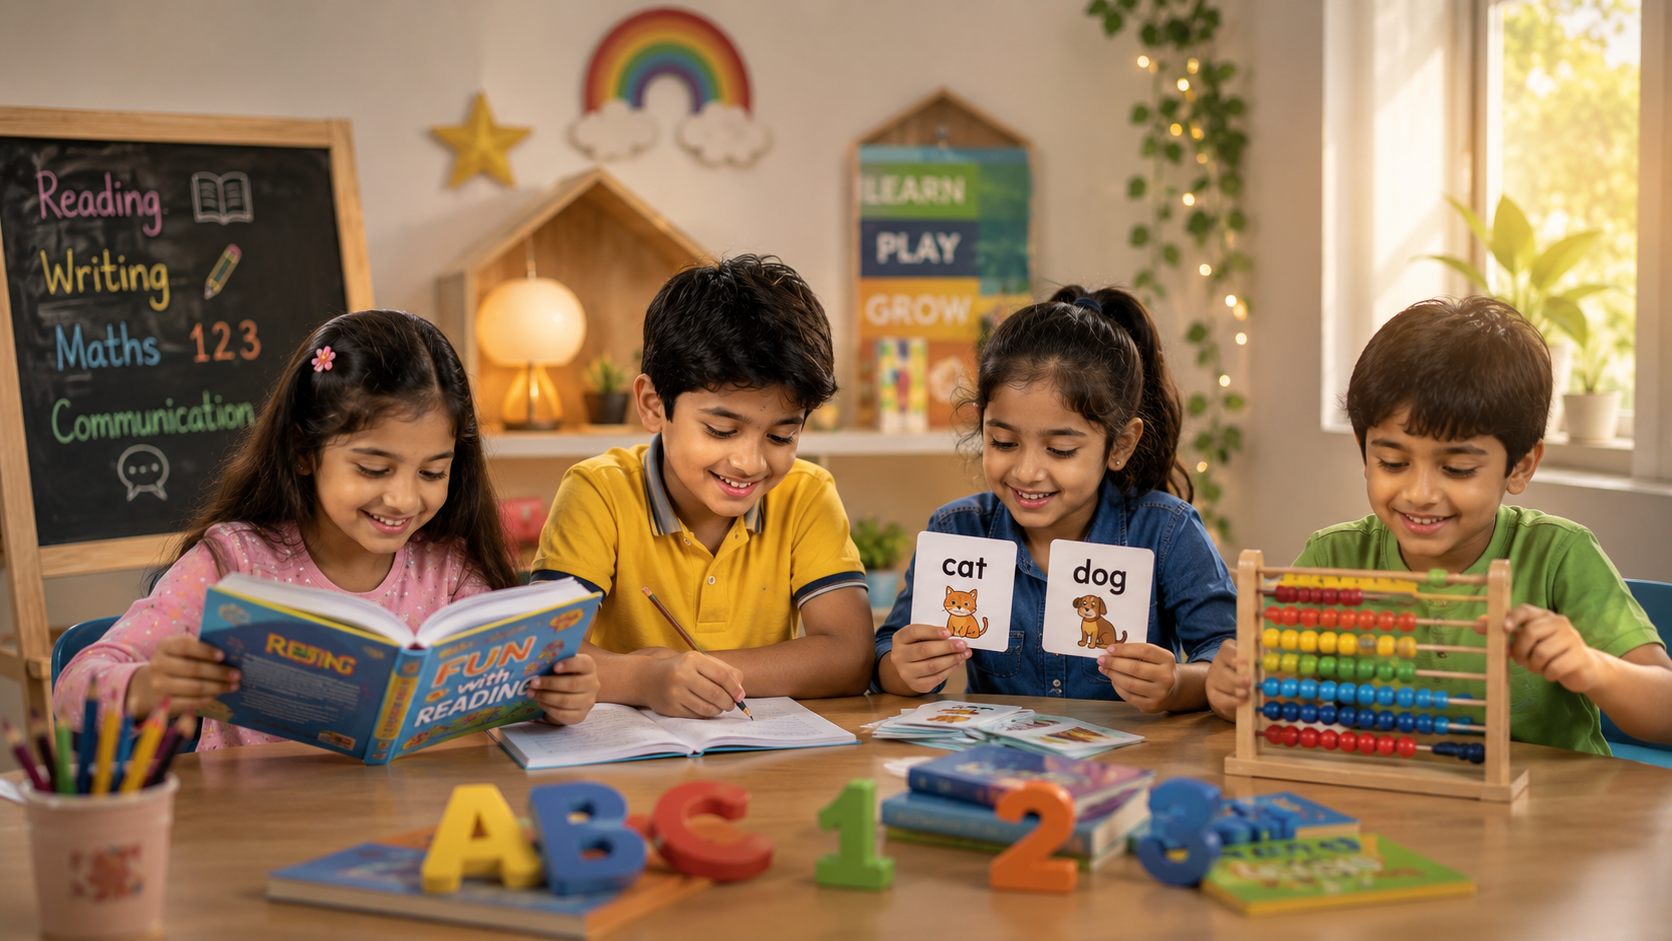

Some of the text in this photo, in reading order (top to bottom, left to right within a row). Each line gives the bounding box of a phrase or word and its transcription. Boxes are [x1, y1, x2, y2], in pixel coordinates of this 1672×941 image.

[863, 175, 966, 205] LEARN
[876, 231, 960, 264] PLAY
[40, 248, 170, 311] Writing
[865, 293, 972, 326] GROW
[55, 321, 161, 371] Maths
[51, 390, 255, 444] Communication
[942, 557, 987, 580] cat
[1072, 558, 1127, 595] dog
[431, 635, 537, 688] FUN
[457, 668, 510, 694] with
